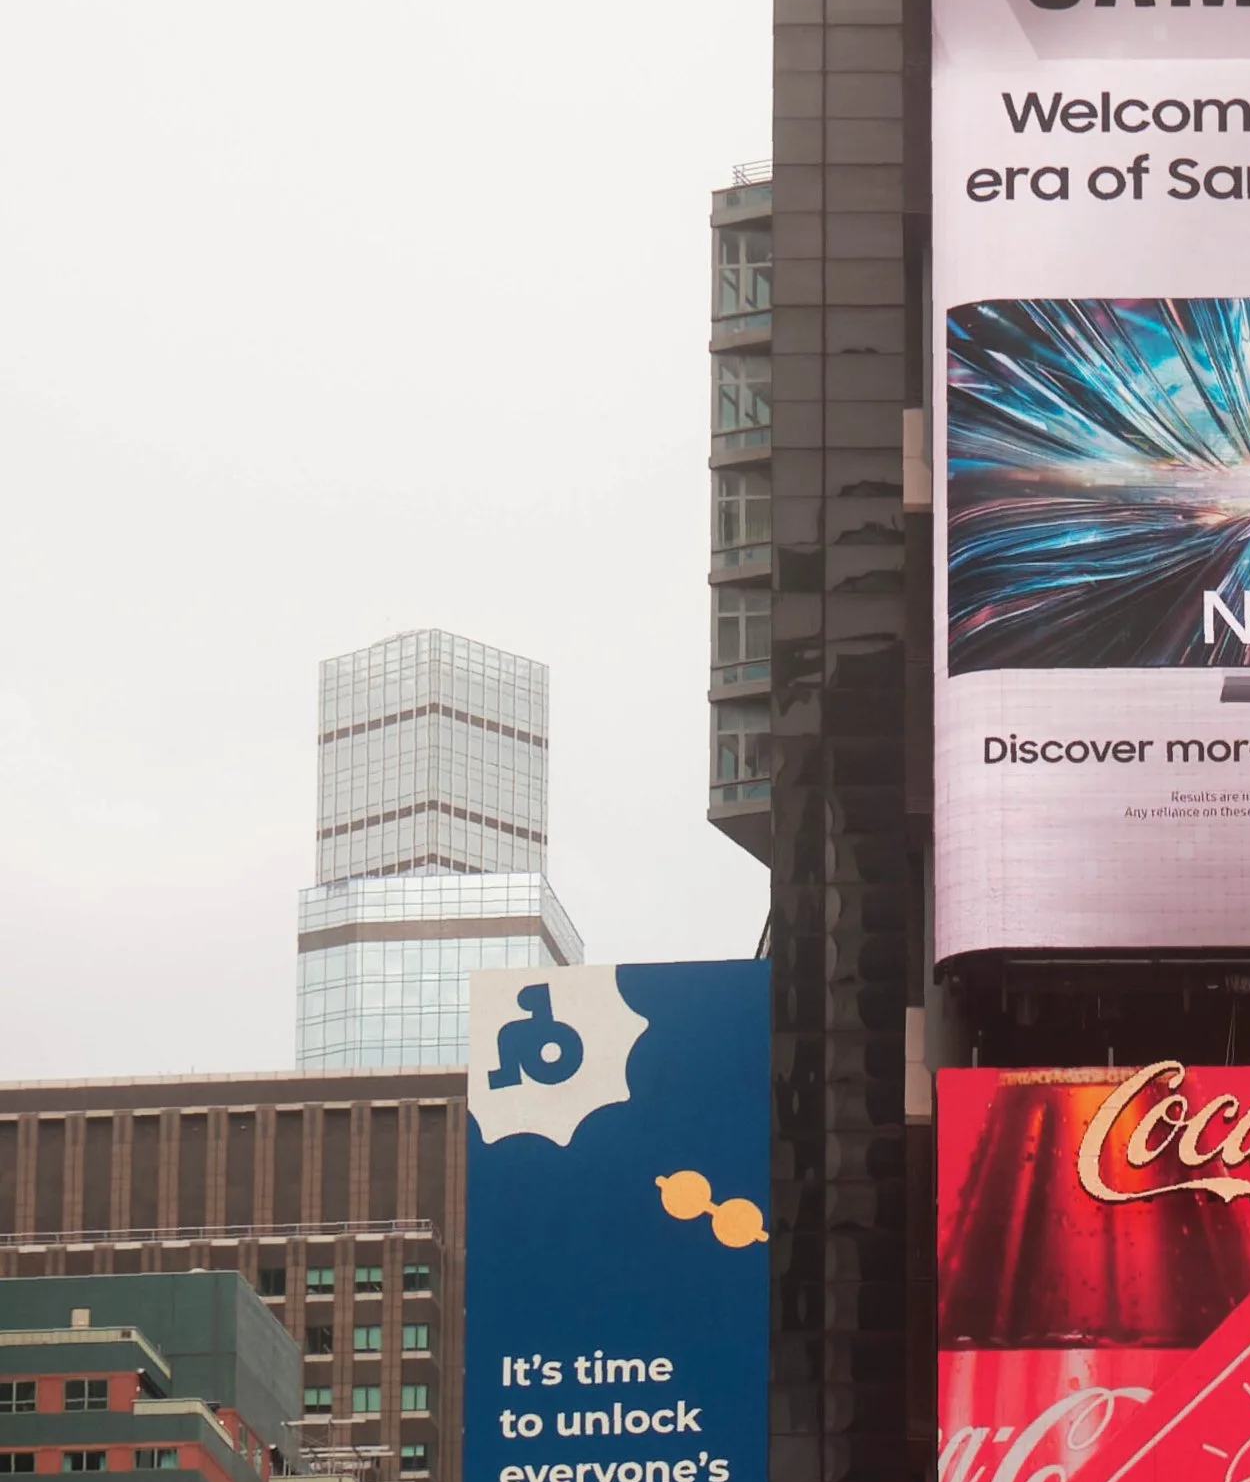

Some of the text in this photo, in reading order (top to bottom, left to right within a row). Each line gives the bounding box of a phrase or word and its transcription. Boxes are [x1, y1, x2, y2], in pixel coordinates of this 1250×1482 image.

[966, 166, 1070, 203] era
[1087, 152, 1150, 201] of
[983, 733, 1155, 765] Discover
[1124, 805, 1148, 819] Any
[1202, 805, 1218, 818] on
[1171, 789, 1217, 803] Results
[1219, 789, 1240, 803] are
[502, 1349, 674, 1387] It's time
[499, 1400, 702, 1439] to unlock
